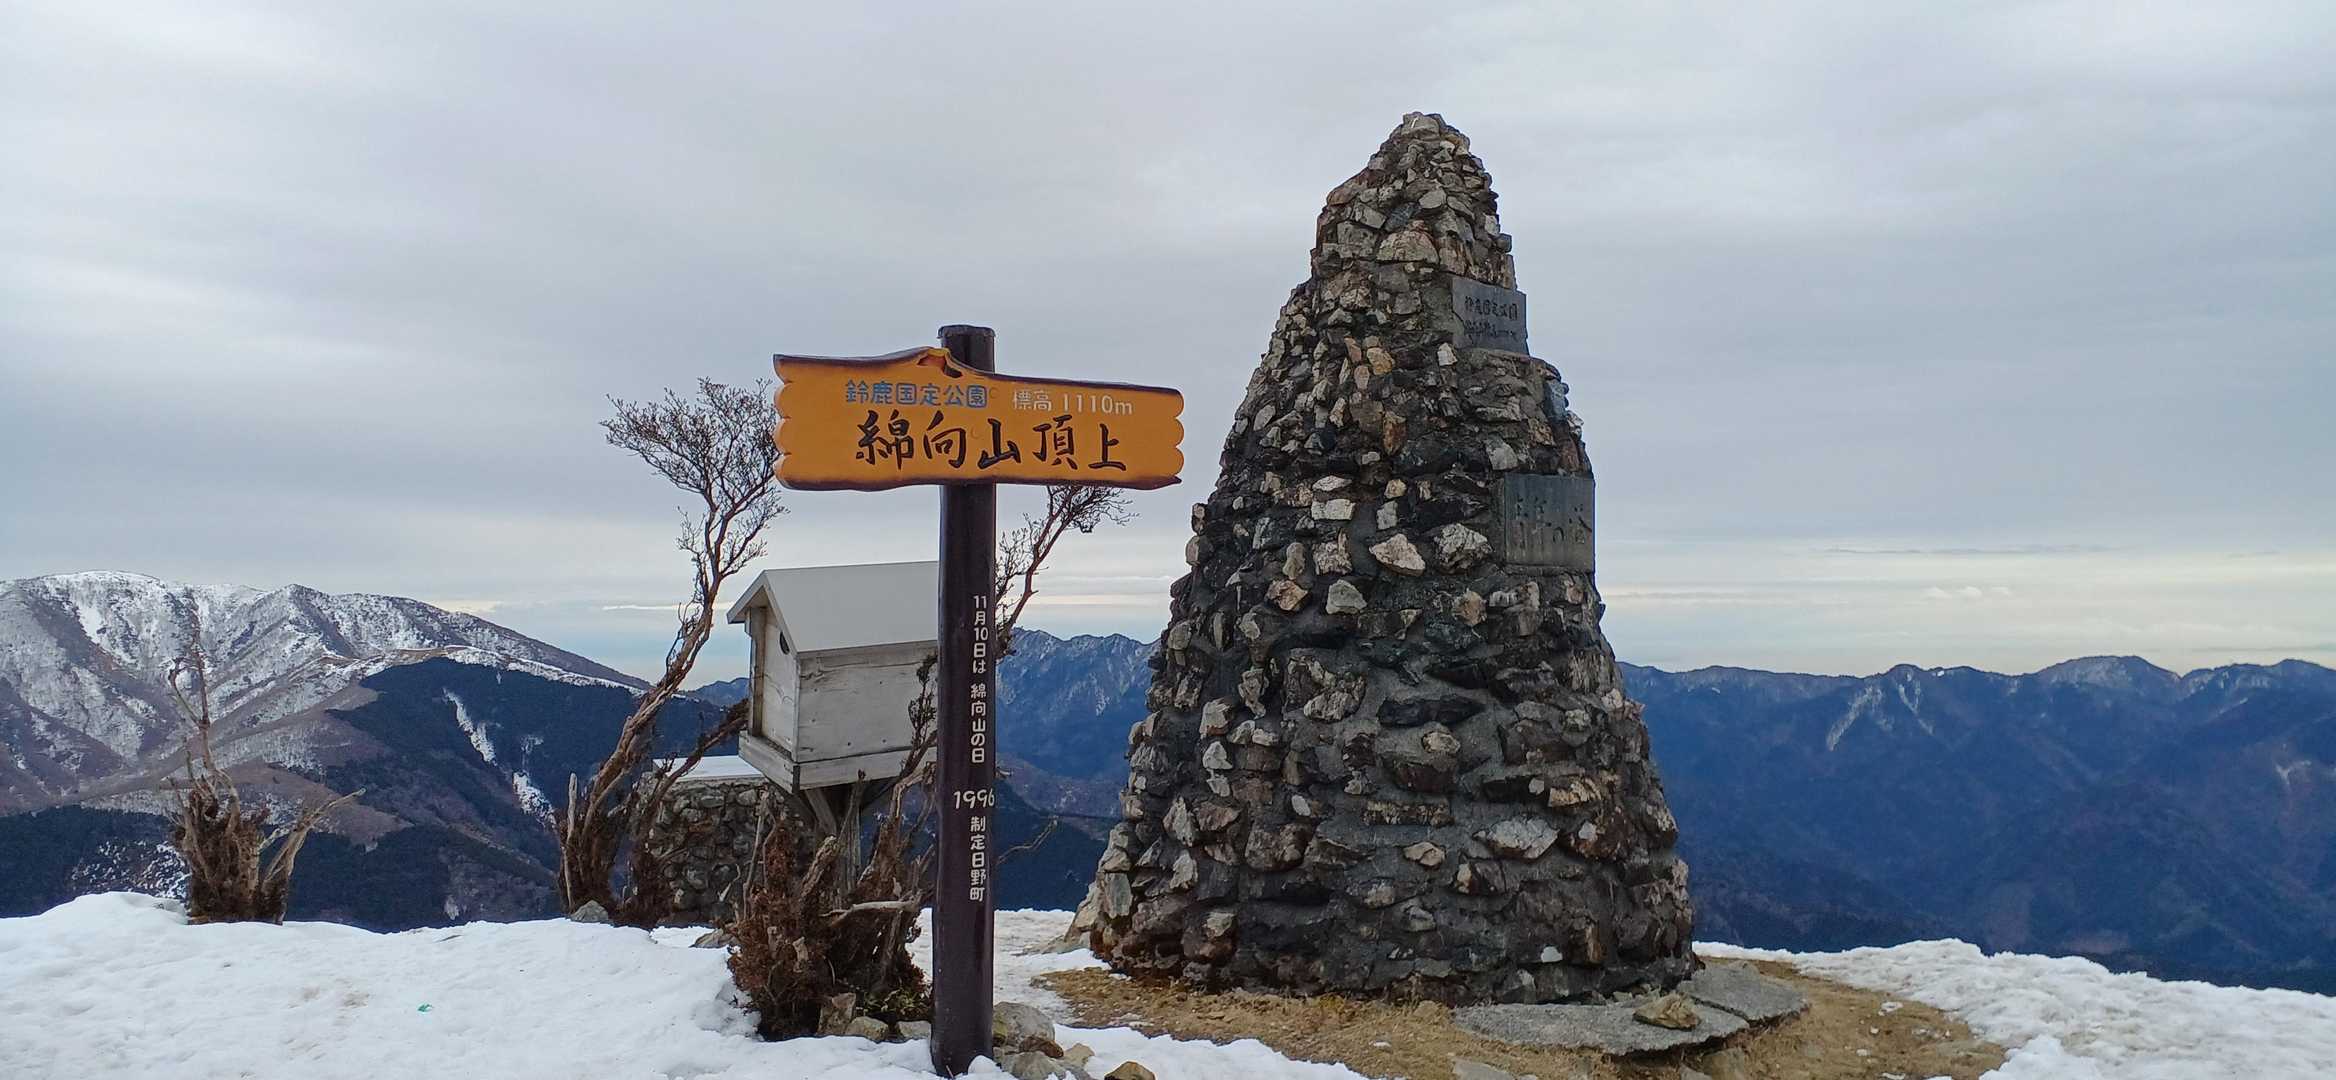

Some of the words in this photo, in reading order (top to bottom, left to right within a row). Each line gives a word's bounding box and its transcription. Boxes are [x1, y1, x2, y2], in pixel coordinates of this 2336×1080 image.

[845, 379, 988, 408] 鈴鹿国定公園
[1012, 389, 1052, 411] 標高
[1063, 393, 1132, 415] 1110m
[856, 409, 1127, 471] 綿向山頂上
[972, 595, 989, 674] 11月10日は
[970, 683, 986, 763] 綿向山の日
[953, 788, 995, 809] 1996
[969, 816, 986, 902] 制定日野町
